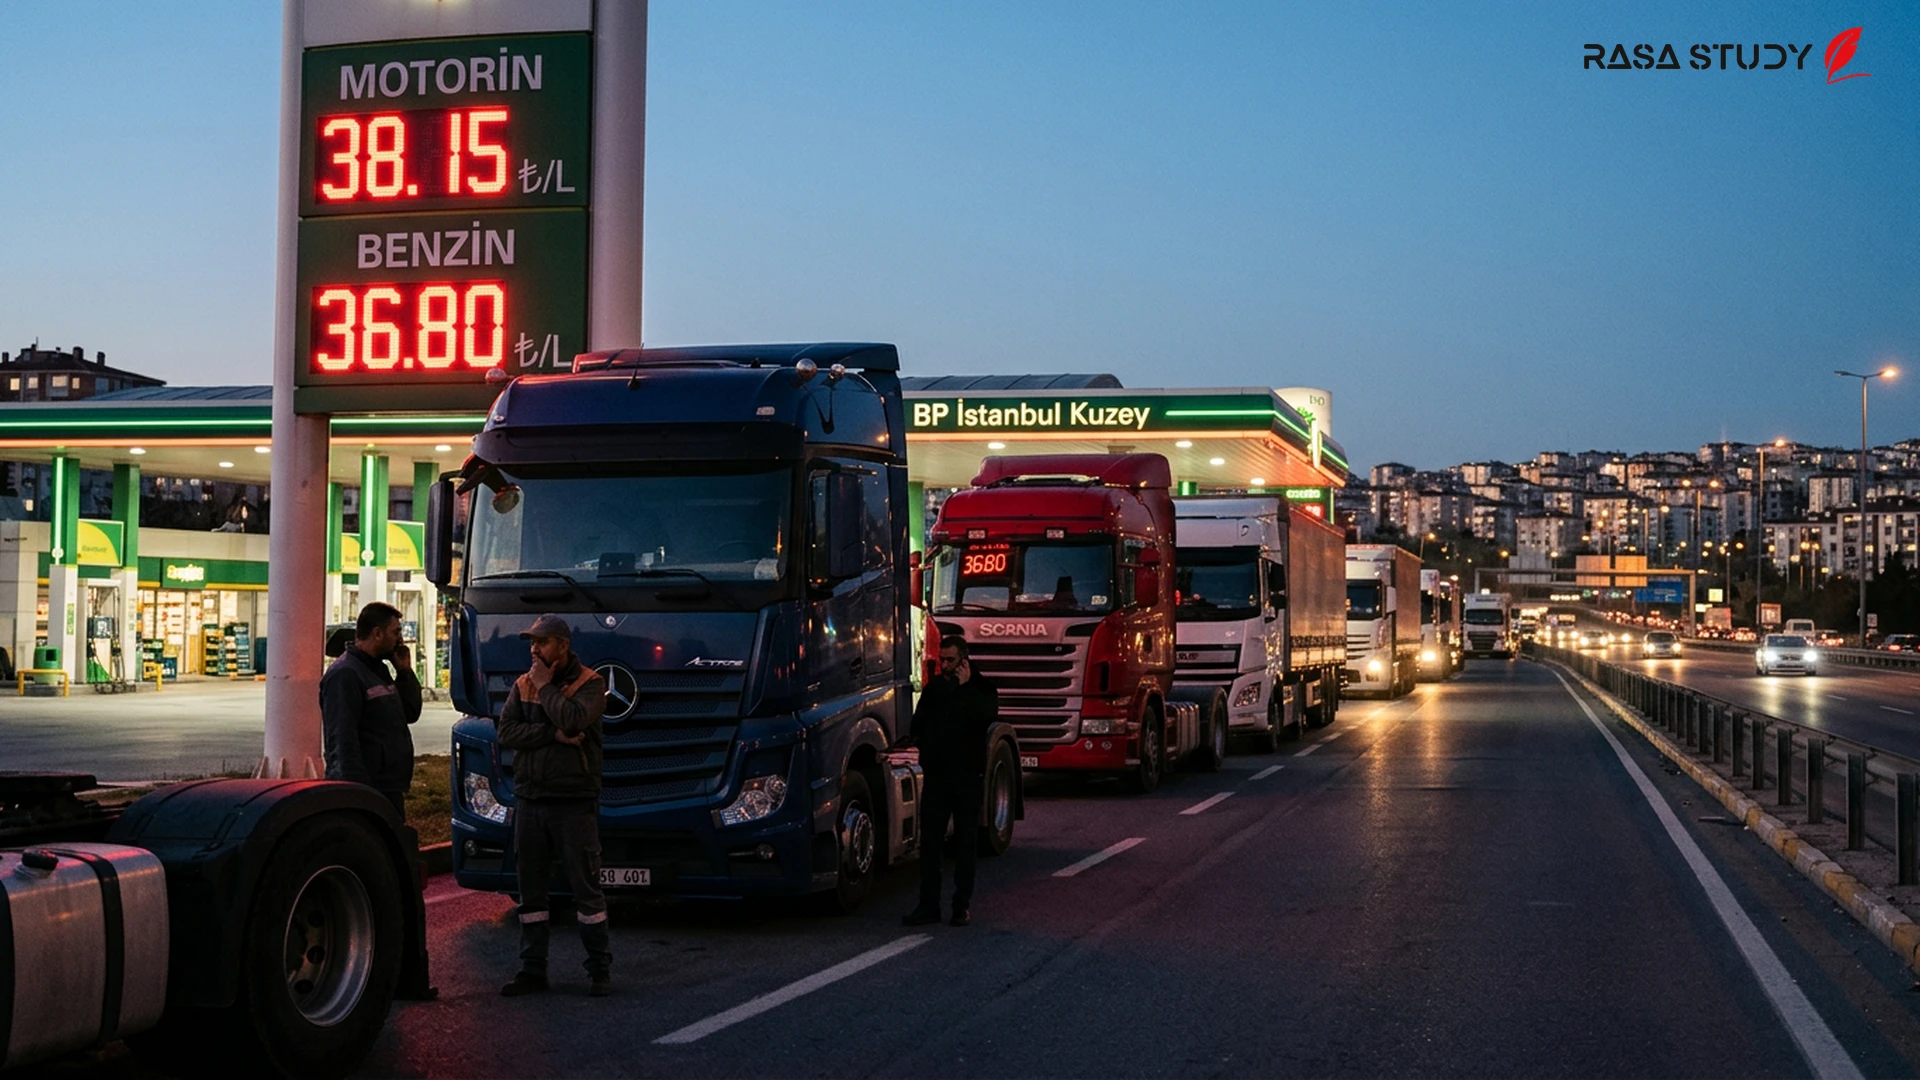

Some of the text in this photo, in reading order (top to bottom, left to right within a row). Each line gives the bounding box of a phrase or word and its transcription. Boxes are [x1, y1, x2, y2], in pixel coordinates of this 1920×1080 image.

[340, 47, 543, 100] MOTORİN
[357, 220, 516, 269] BENZİN
[317, 283, 504, 371] 36.80
[913, 398, 1151, 430] BP İstanbul Kuzey
